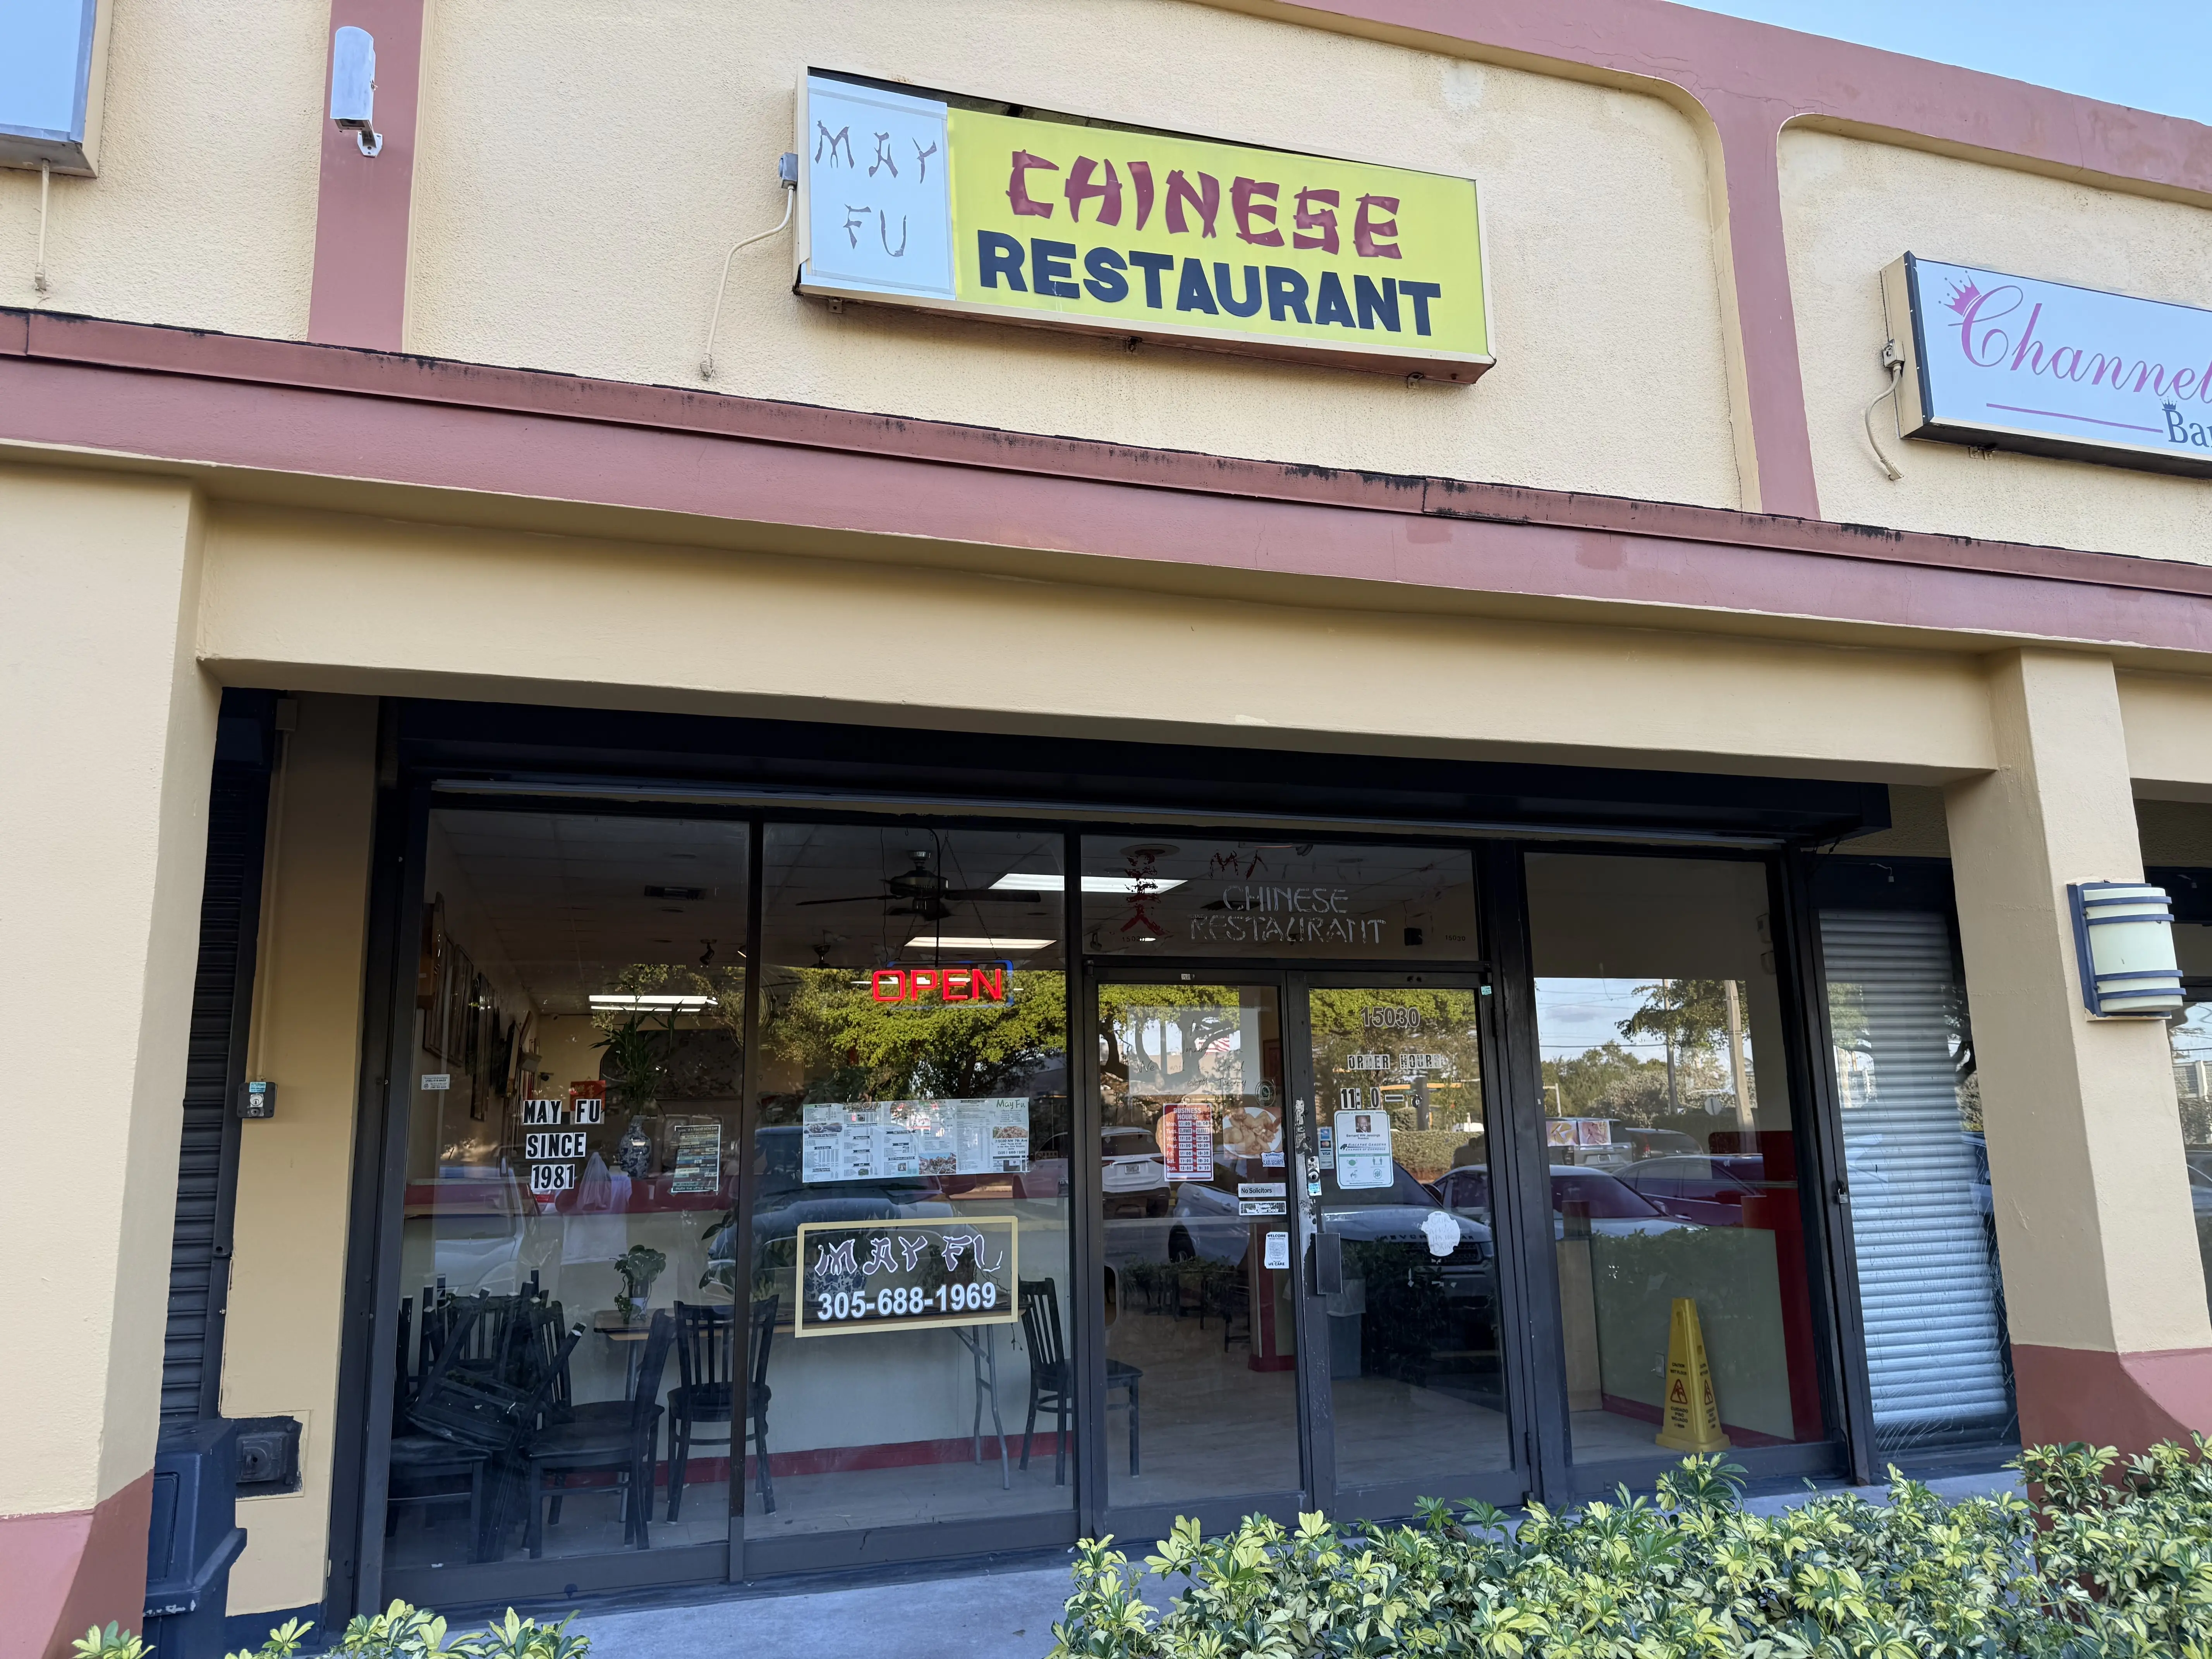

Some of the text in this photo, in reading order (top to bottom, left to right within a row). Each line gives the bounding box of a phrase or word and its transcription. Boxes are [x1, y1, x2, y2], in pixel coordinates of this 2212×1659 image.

[814, 119, 937, 184] MAY
[1005, 148, 1401, 260] CHINESE
[843, 203, 907, 258] FU
[977, 230, 1441, 336] RESTAURANT
[2162, 407, 2212, 448] Ba
[1223, 885, 1349, 914] CHINESE
[1188, 914, 1386, 944] RESTAURANT
[872, 968, 1002, 1002] OPEN
[1360, 1007, 1420, 1027] 15030
[1137, 1060, 1155, 1073] We
[1348, 1055, 1389, 1069] ORDER
[524, 1100, 601, 1123] MAY FU
[996, 1099, 1026, 1109] May Fu
[527, 1133, 584, 1158] SINCE
[532, 1165, 574, 1189] 1981
[814, 1234, 1003, 1276] MAY FU
[817, 1281, 997, 1321] 305-688-1969
